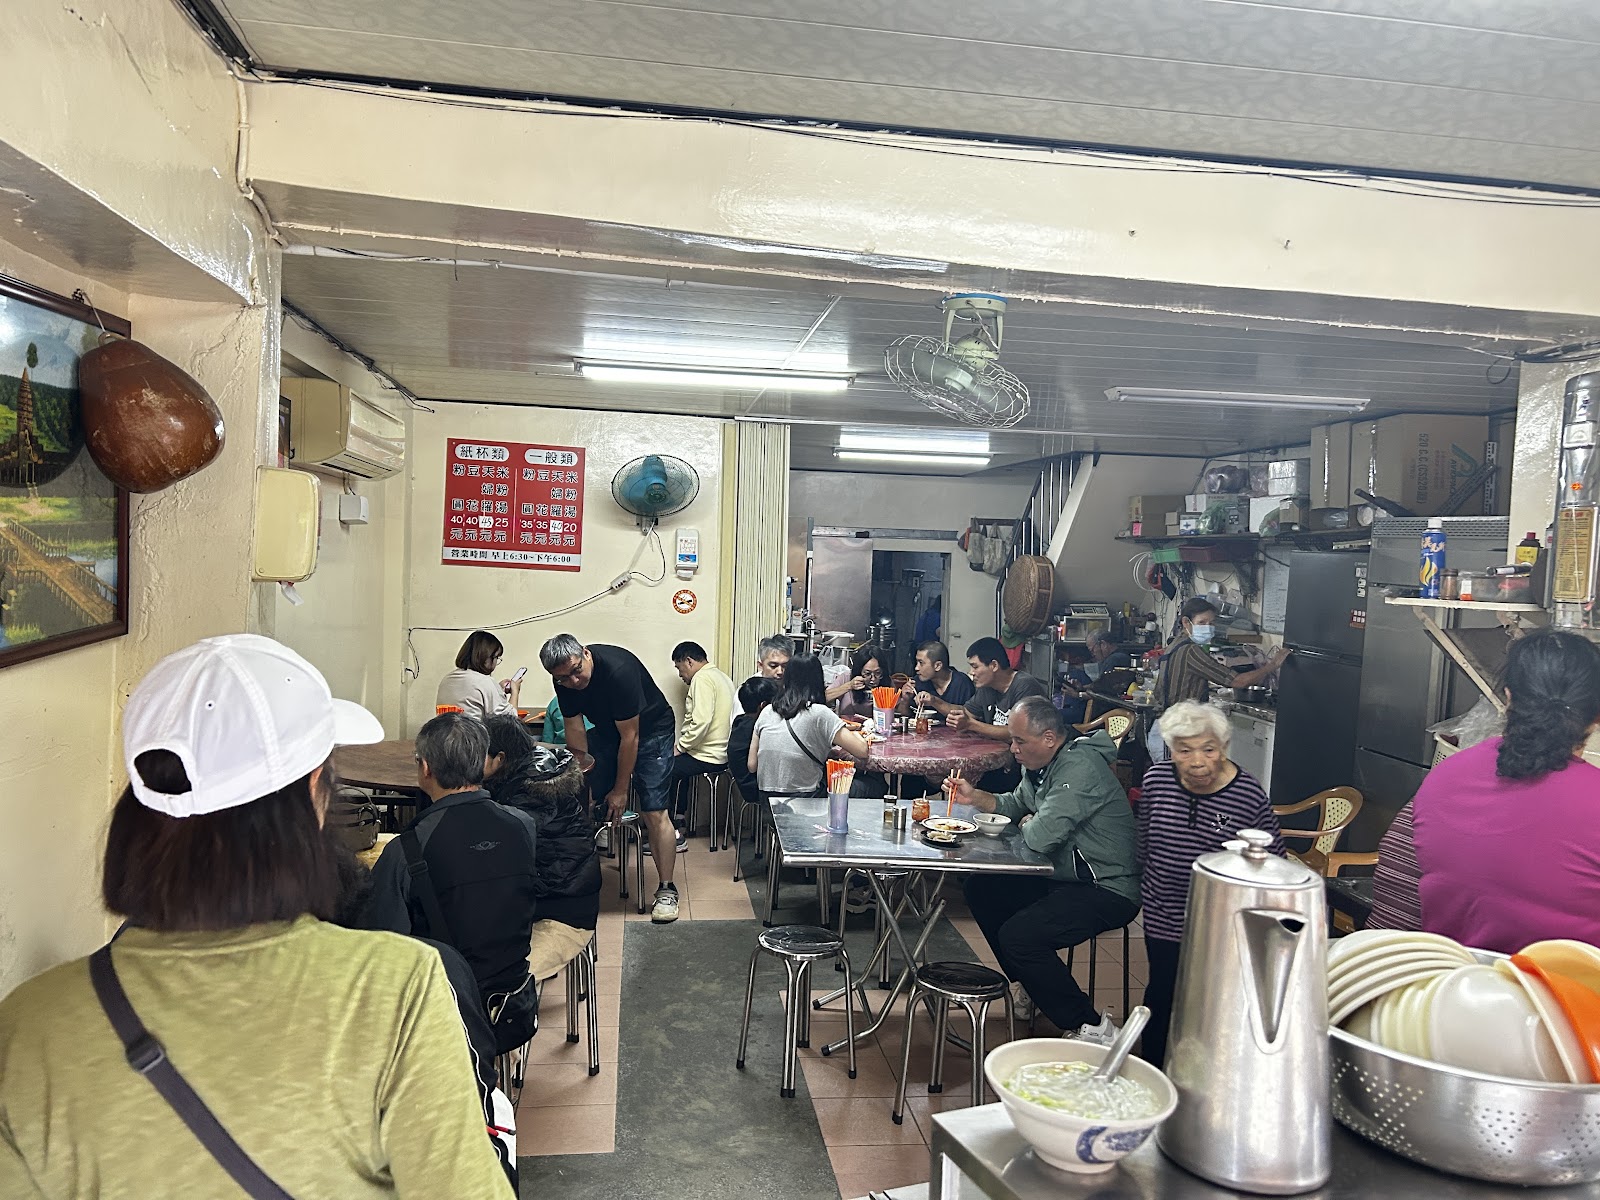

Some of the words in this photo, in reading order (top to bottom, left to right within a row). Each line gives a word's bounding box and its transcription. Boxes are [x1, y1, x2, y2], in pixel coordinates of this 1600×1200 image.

[1418, 433, 1429, 447] 520
[460, 446, 505, 460] 紙杯類
[529, 451, 573, 465] 一般類
